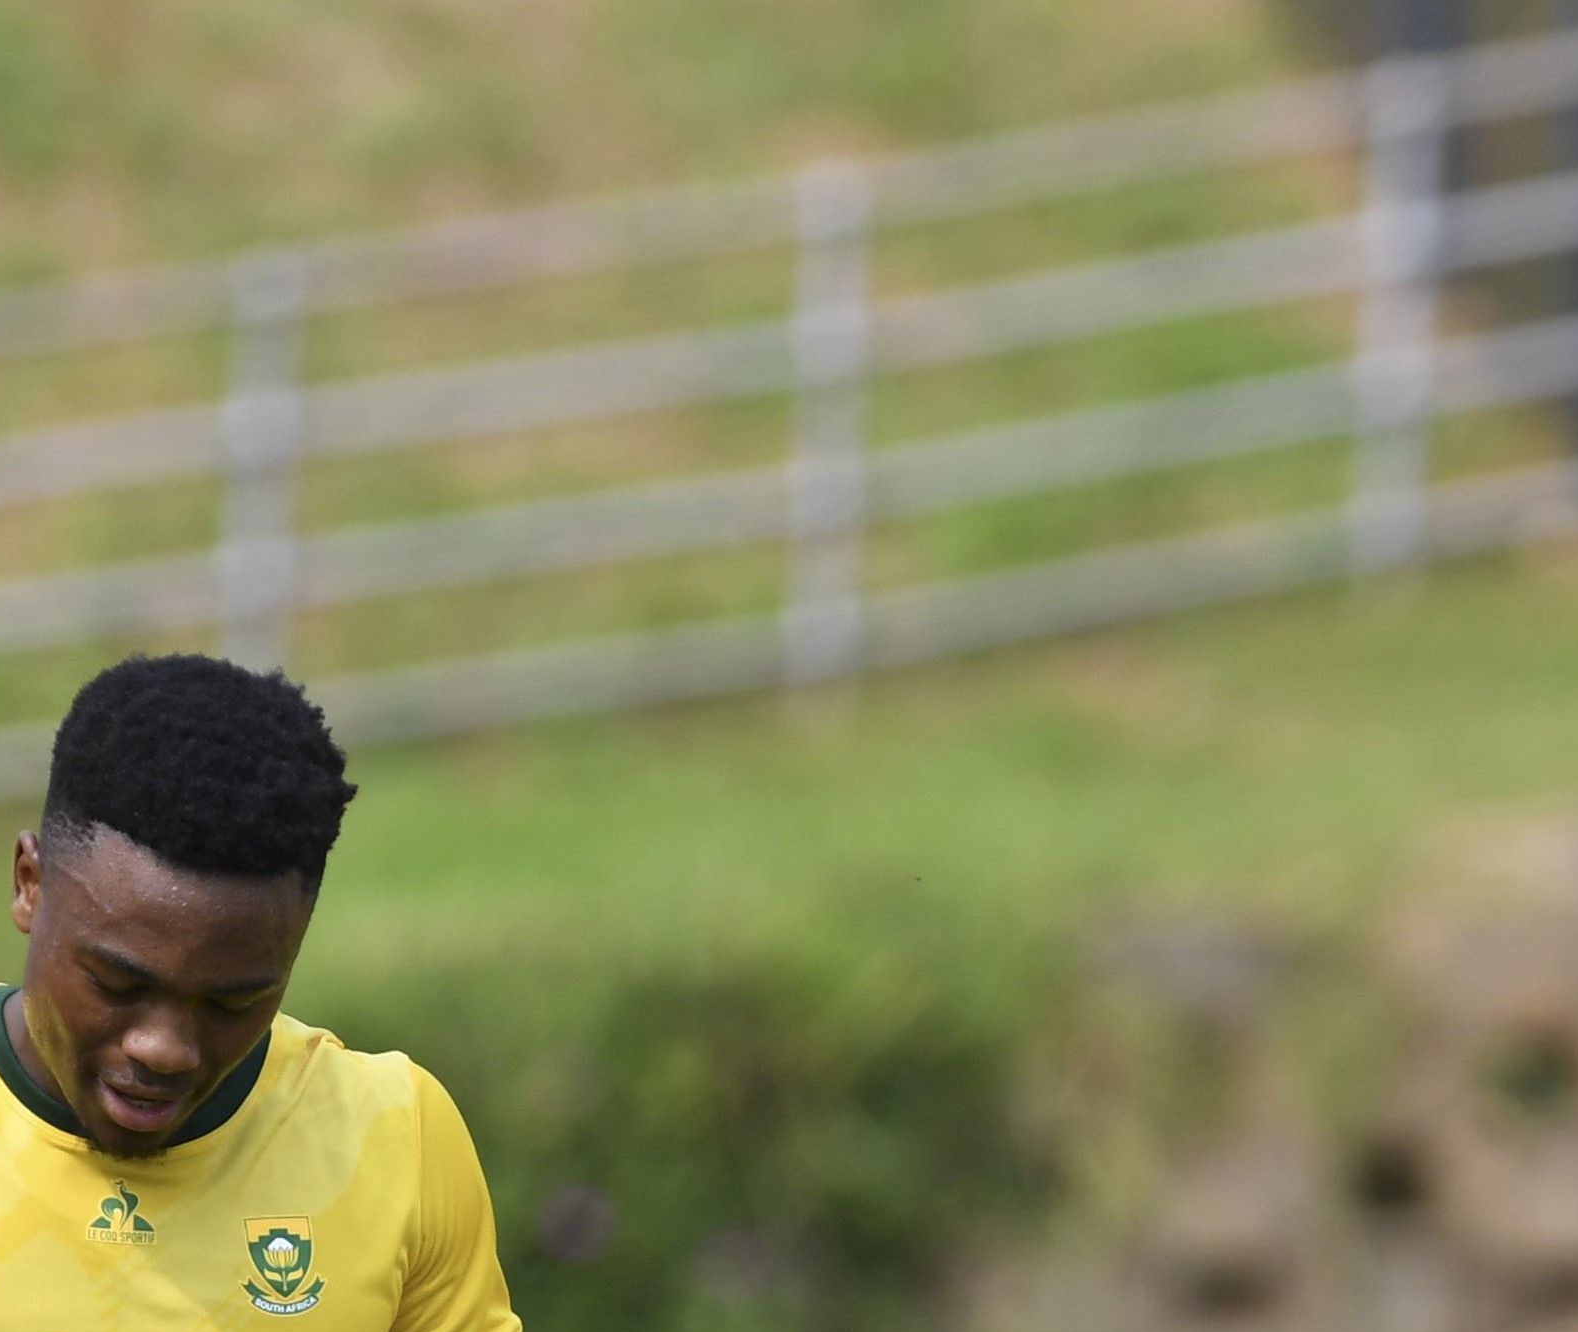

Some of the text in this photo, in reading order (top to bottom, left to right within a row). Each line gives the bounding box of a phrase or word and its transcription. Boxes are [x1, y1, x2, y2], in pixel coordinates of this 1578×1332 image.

[87, 1228, 155, 1243] LE COQ SPORTIF
[255, 1296, 317, 1313] SOUTH AFRICA
